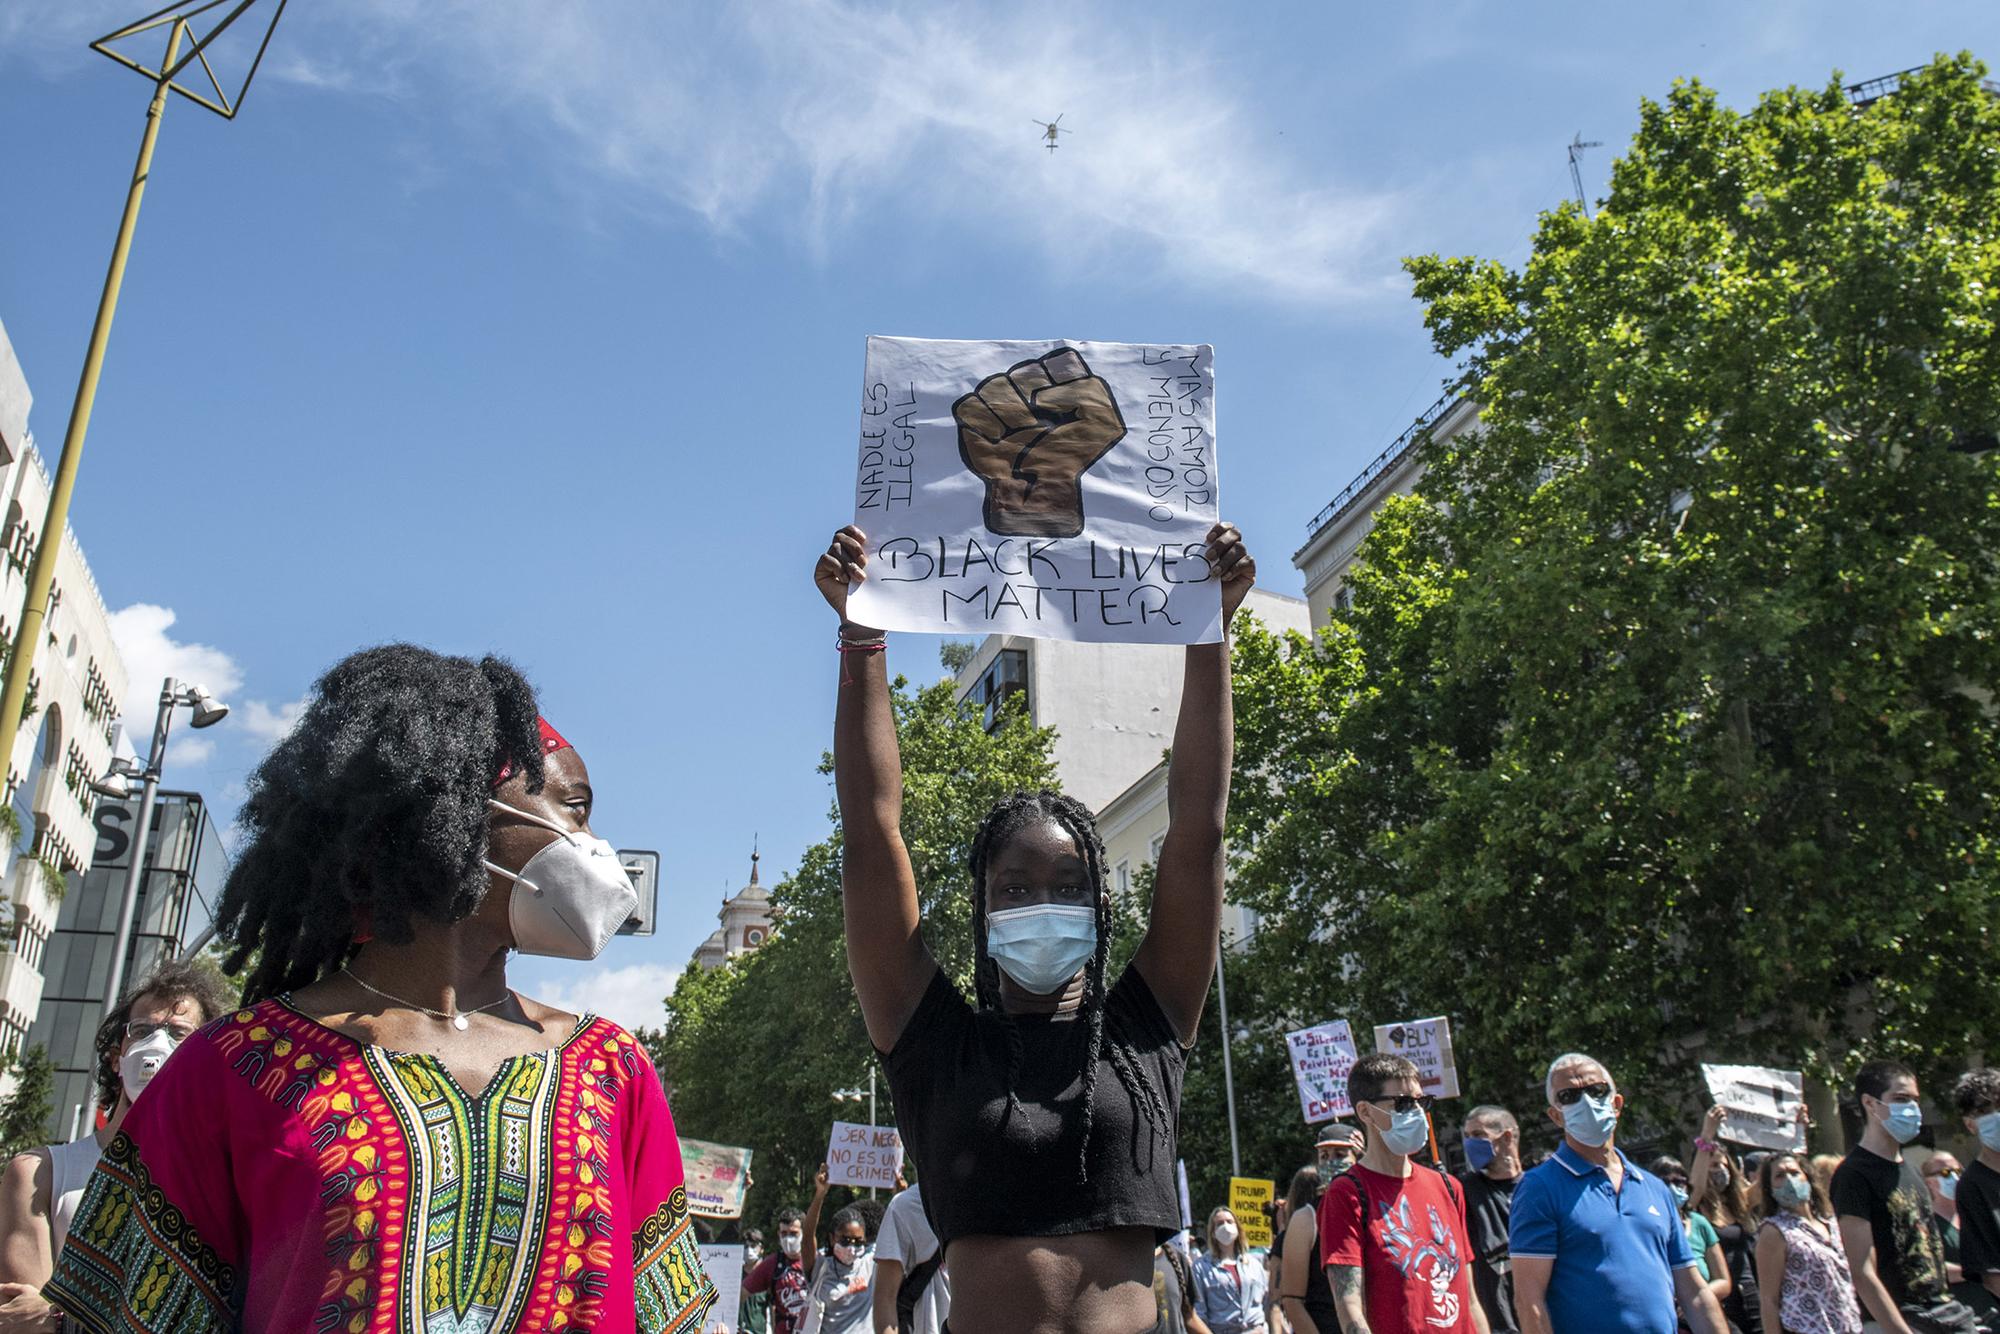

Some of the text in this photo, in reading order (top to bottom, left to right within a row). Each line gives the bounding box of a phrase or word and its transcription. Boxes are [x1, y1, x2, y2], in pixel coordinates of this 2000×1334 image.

[864, 383, 888, 416] ES
[1147, 376, 1175, 461] MENOS
[886, 381, 917, 511] ILEGAL
[1180, 426, 1210, 512] AMOR
[879, 536, 1212, 583] BLACK LIVES
[943, 582, 1181, 626] MATTER
[1406, 1027, 1436, 1049] BLM
[831, 1148, 898, 1168] NO ES UN
[839, 1126, 868, 1146] SER
